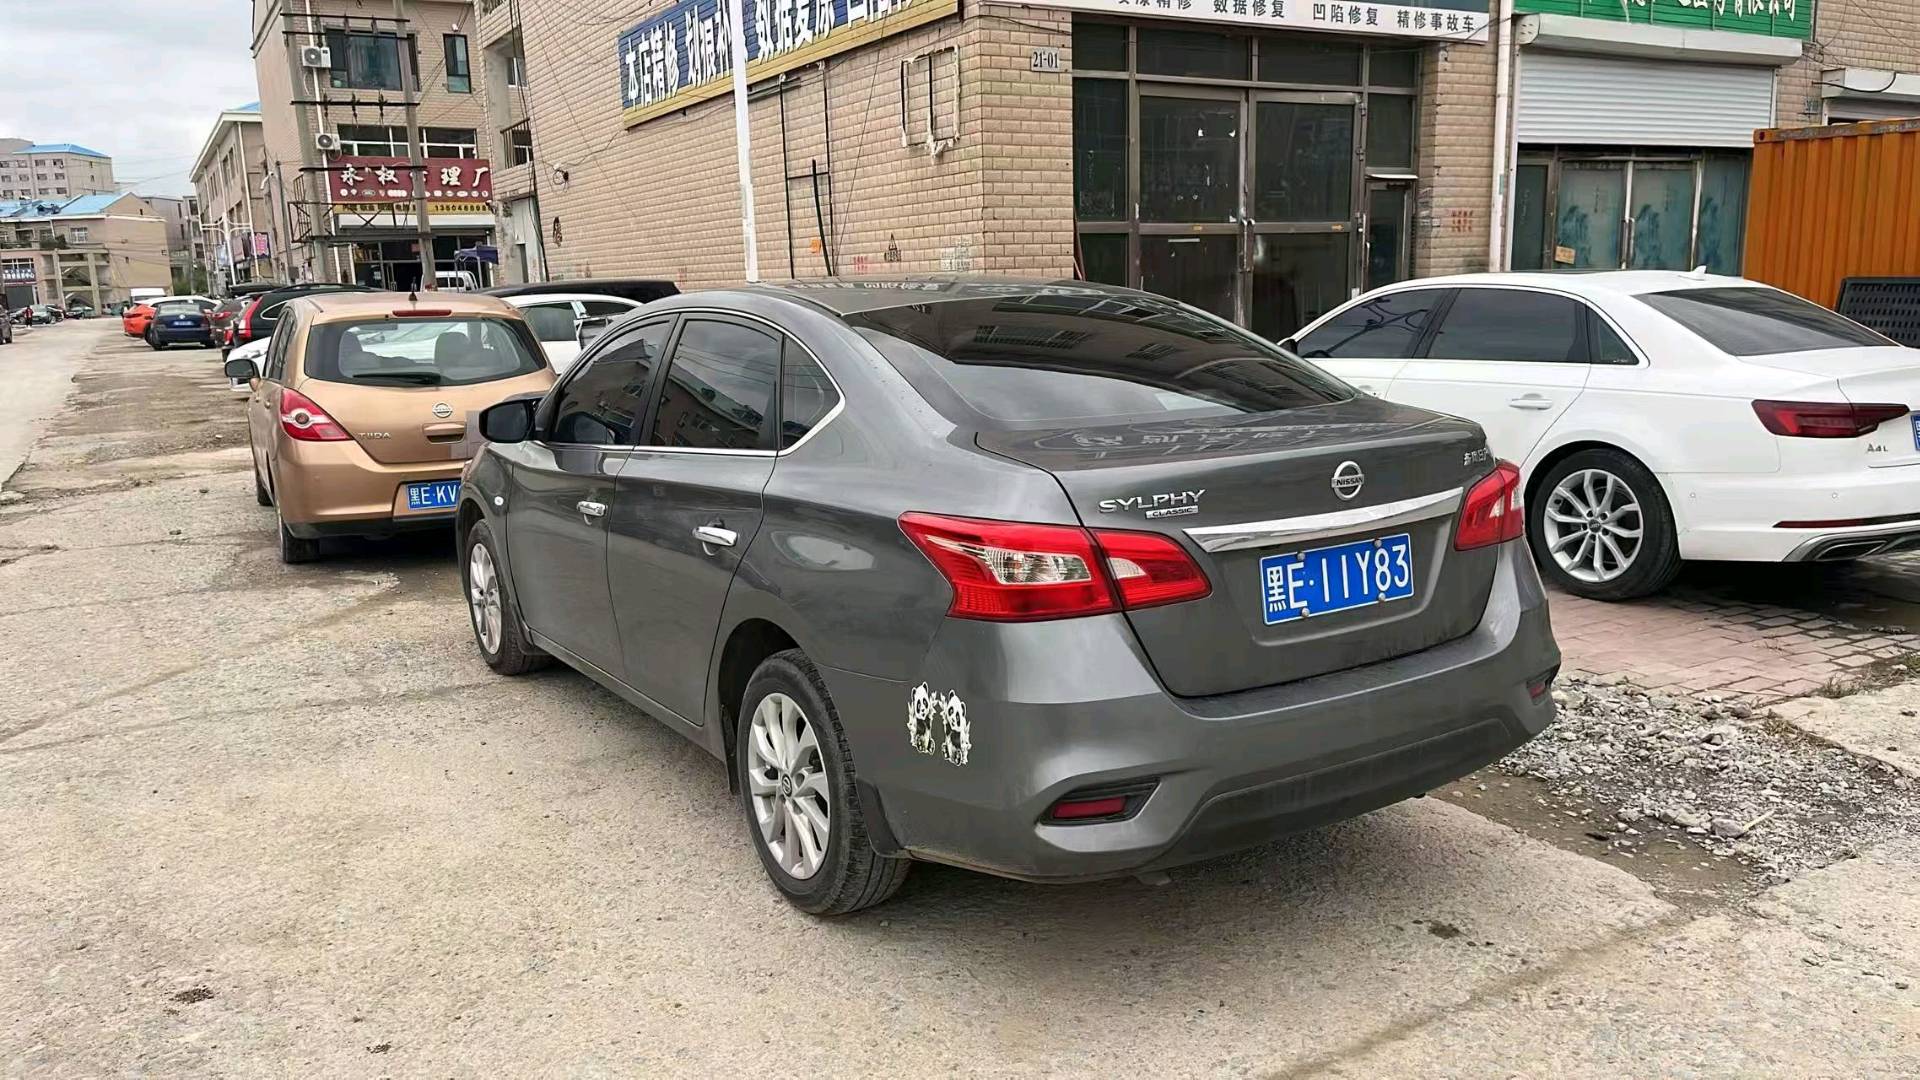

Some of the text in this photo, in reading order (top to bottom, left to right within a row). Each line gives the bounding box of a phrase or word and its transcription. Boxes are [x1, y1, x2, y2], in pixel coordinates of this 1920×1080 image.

[1312, 3, 1379, 26] 凹陷修复
[1396, 9, 1475, 33] 精修事故车
[626, 20, 680, 113] 本店精修
[1032, 50, 1059, 69] 21-01
[340, 163, 489, 188] 永权理厂
[1335, 474, 1364, 487] NISSAN
[1098, 489, 1206, 514] SYLPHY
[1149, 506, 1196, 518] CLASSIC
